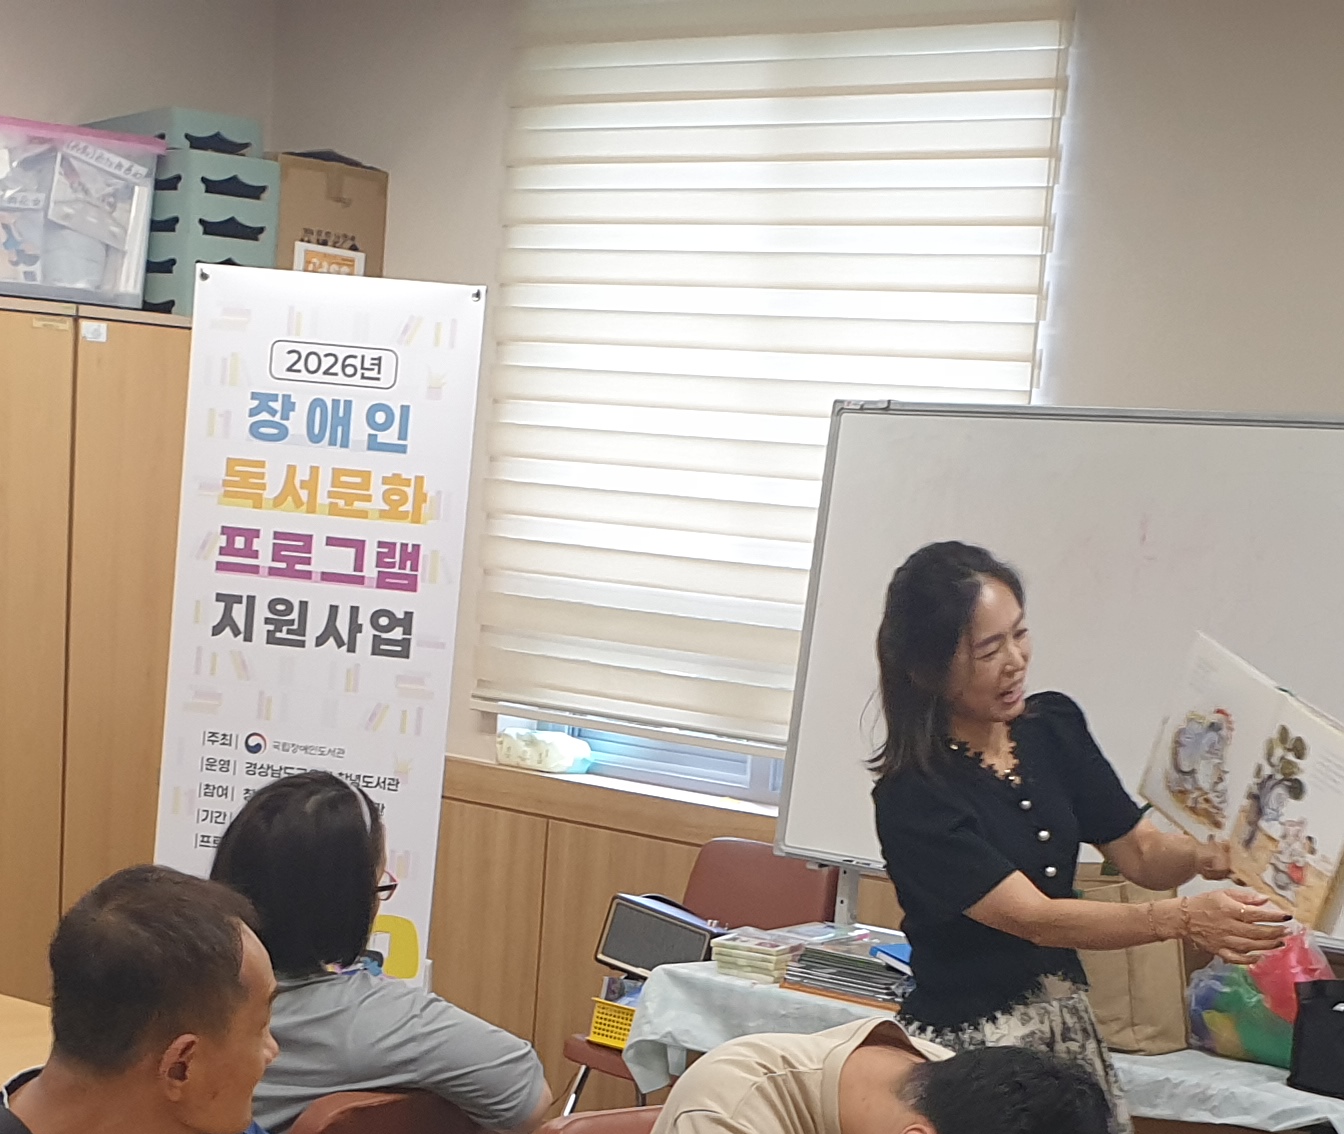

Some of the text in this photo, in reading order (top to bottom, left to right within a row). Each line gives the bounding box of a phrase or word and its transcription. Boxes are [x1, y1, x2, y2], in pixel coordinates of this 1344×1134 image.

[285, 349, 383, 382] 2026년
[248, 391, 411, 454] 장애인
[222, 457, 428, 524] 독서문화
[215, 525, 422, 592] 프로그램
[211, 592, 415, 660] 지원사업
